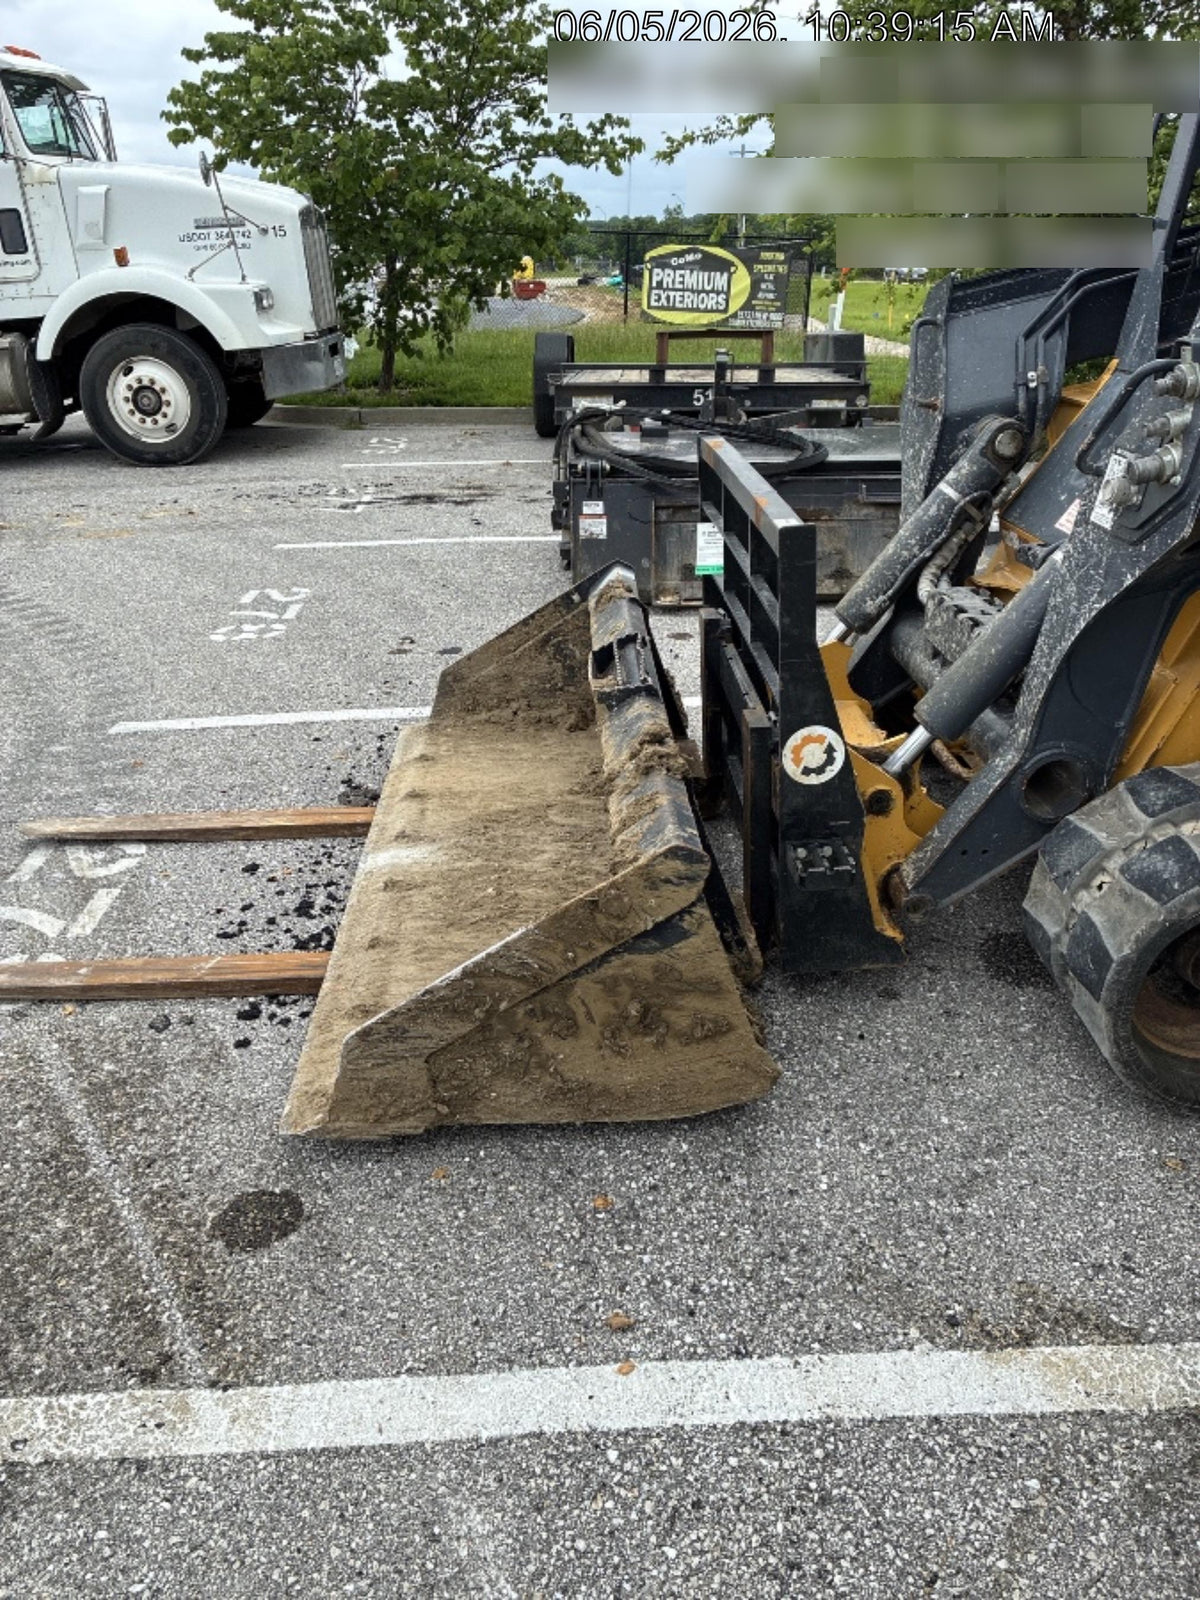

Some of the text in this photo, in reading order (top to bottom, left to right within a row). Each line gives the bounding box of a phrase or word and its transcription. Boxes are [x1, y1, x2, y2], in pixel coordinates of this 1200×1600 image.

[179, 232, 210, 242] USDOT
[271, 225, 287, 237] 15
[652, 267, 729, 293] PREMIUM
[650, 289, 727, 310] EXTERIORS
[209, 587, 311, 642] 278
[0, 843, 147, 962] 27
